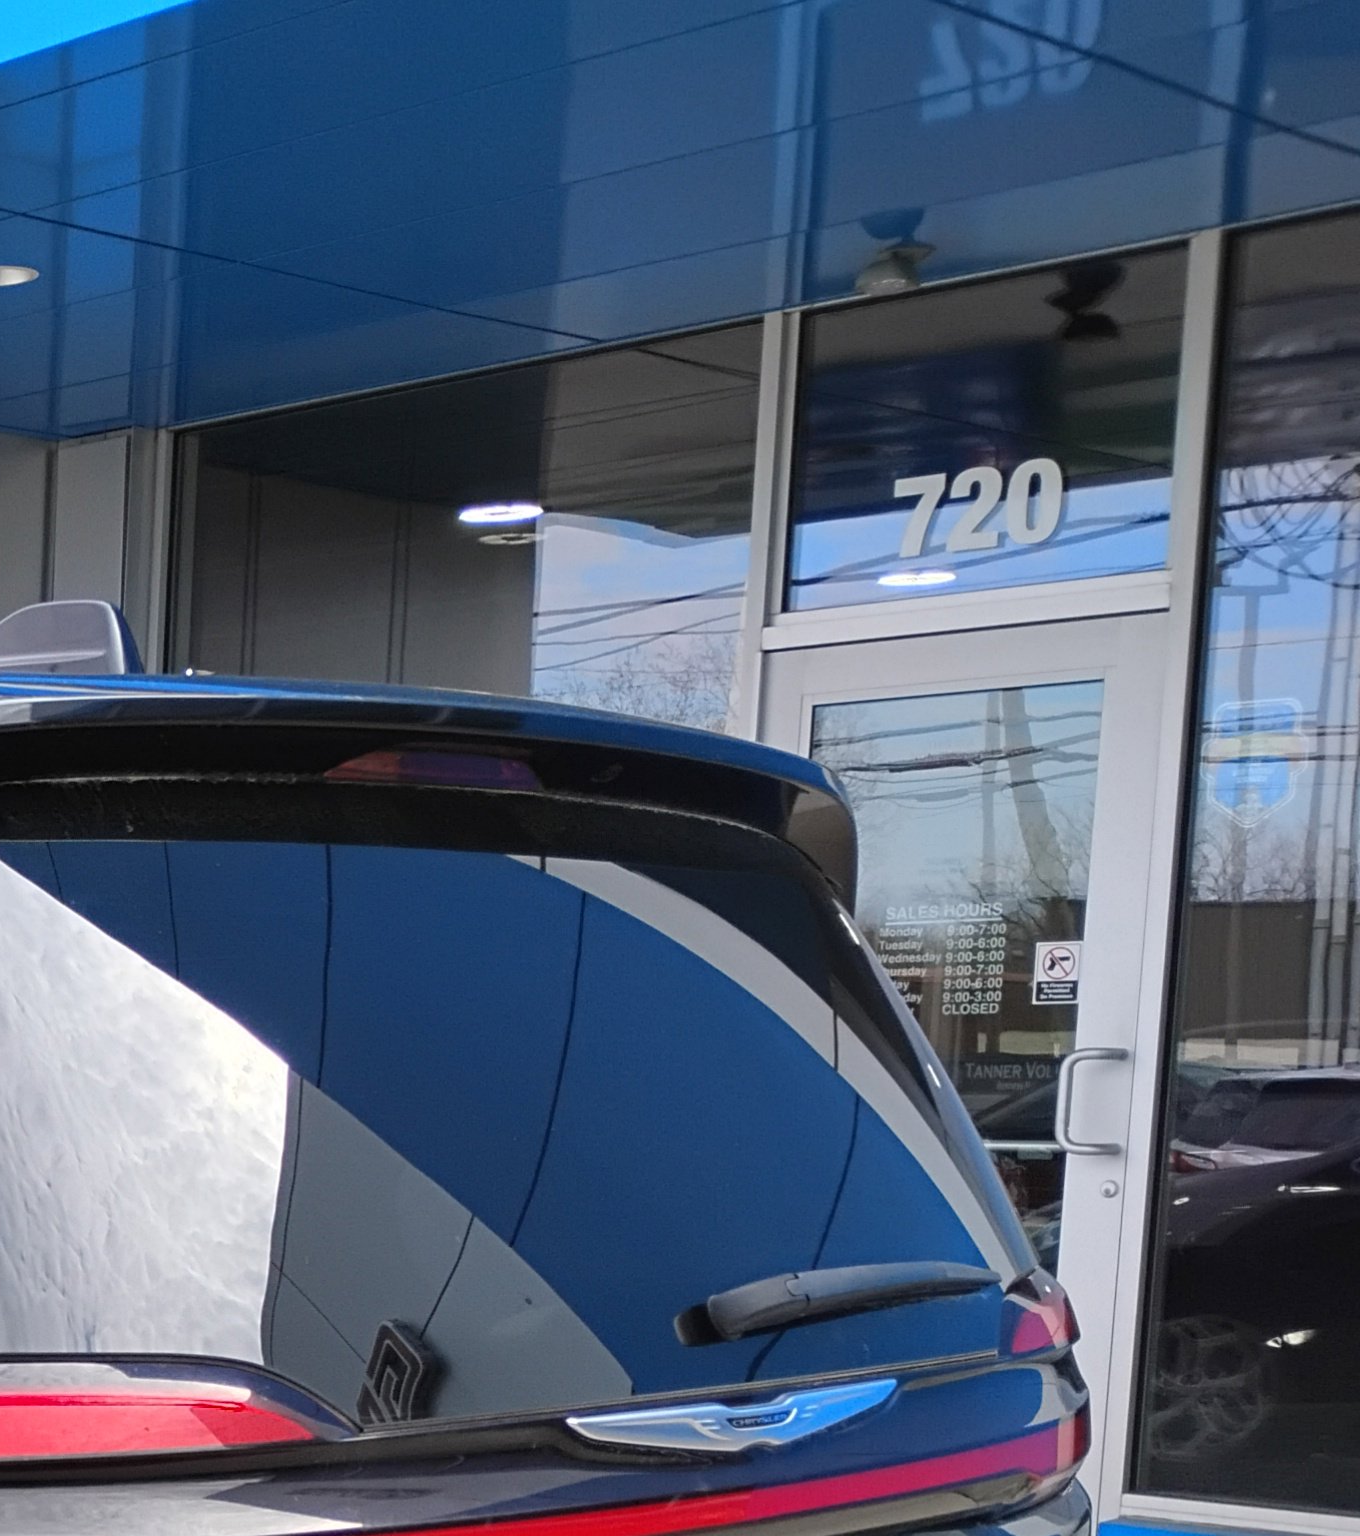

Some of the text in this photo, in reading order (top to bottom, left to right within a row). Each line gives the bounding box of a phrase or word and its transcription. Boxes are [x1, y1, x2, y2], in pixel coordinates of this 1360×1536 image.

[894, 458, 1065, 558] 720
[885, 902, 1004, 921] SALES HOURS
[880, 926, 924, 938] Monday
[880, 937, 1006, 952] Tuesday 9:00-6:00
[878, 950, 1005, 965] Wednesday 9:00-6:00
[944, 964, 1004, 977] 9:00-7:00
[943, 977, 1003, 990] 9:00-6:00
[942, 990, 1002, 1003] 9:00-3:00
[941, 1003, 999, 1015] CLOSED
[965, 1062, 1022, 1079] TANNER
